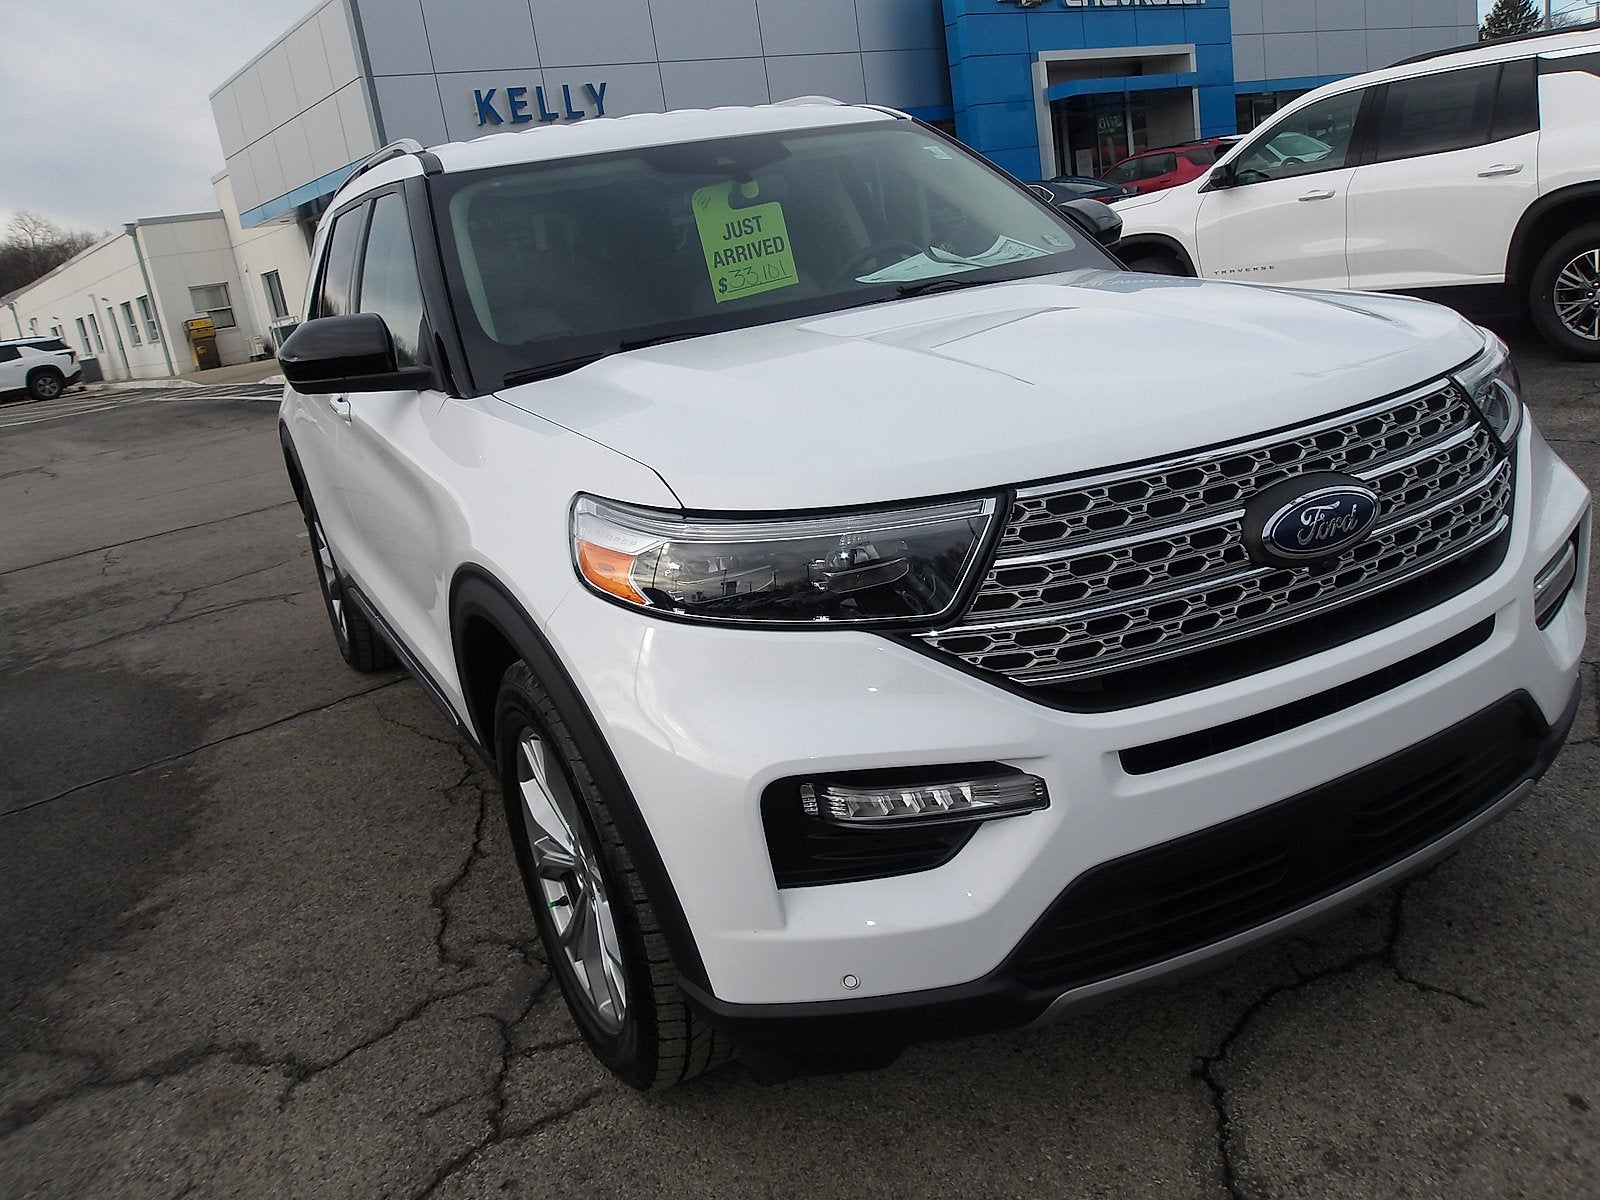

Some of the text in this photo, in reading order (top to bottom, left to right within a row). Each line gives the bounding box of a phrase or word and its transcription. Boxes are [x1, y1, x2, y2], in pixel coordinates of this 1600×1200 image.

[473, 82, 607, 126] KELLY
[722, 215, 762, 241] JUST
[713, 236, 785, 268] ARRIVED
[1297, 501, 1358, 546] Ford
